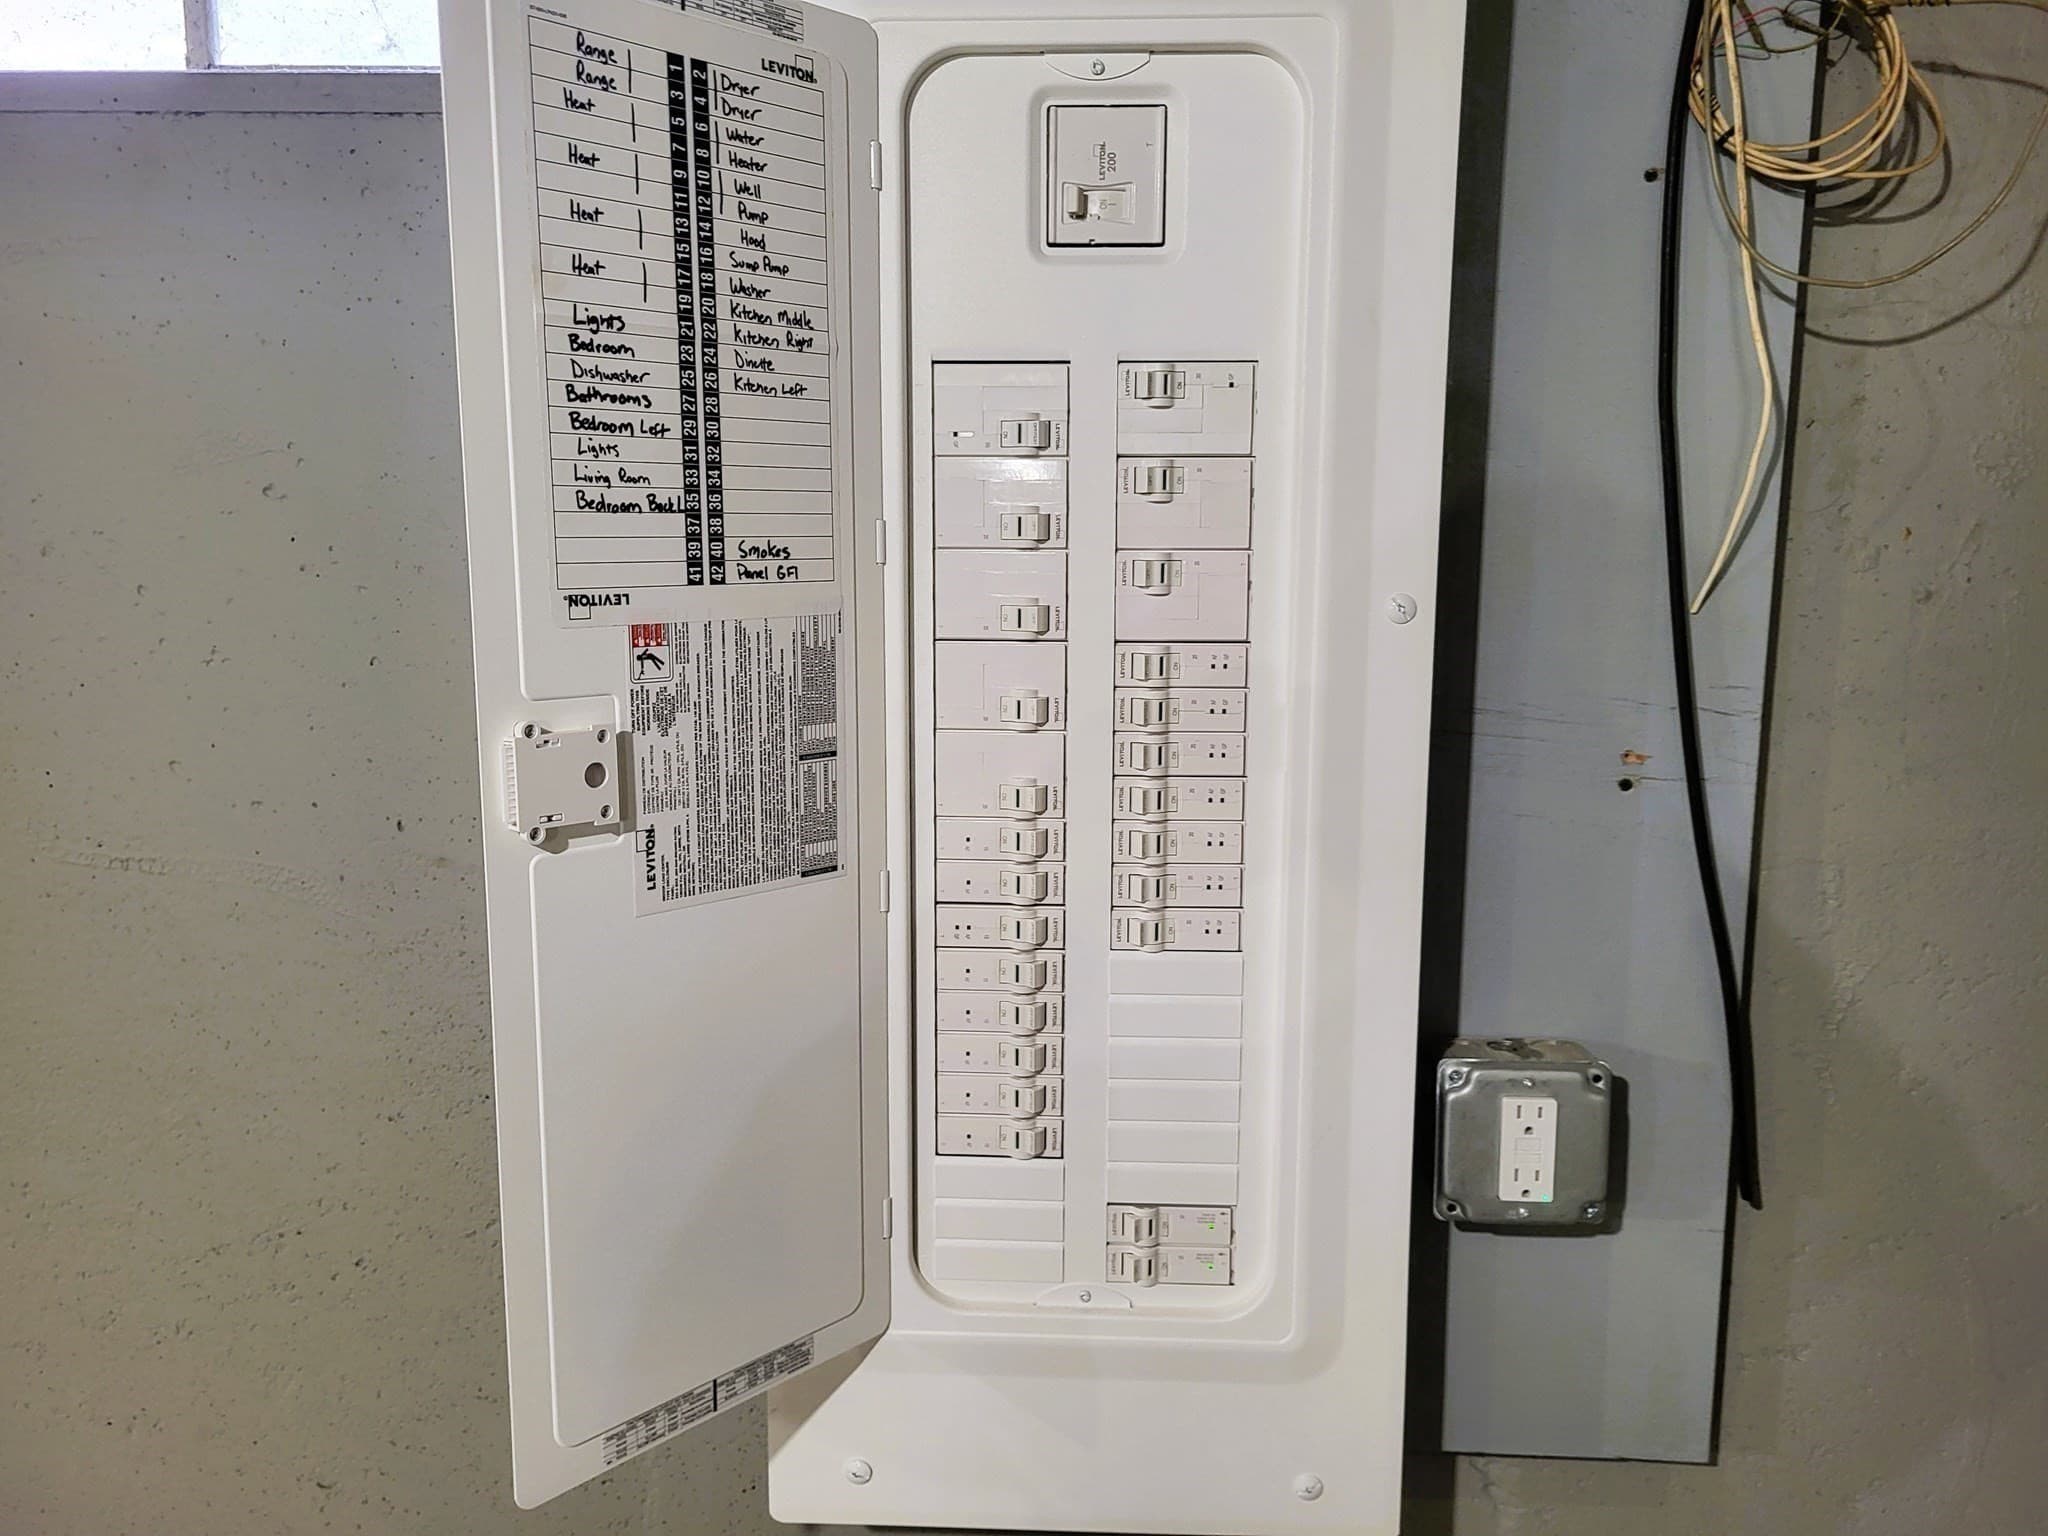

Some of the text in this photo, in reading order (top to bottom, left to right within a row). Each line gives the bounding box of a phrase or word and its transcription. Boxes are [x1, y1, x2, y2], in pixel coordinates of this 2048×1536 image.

[576, 31, 617, 65] Range
[576, 60, 617, 91] Range
[694, 70, 706, 79] 2
[761, 58, 814, 83] LEVITON
[721, 72, 760, 97] Dryer
[563, 88, 595, 113] Heat
[671, 90, 684, 101] 3
[695, 96, 706, 105] 4
[723, 98, 762, 120] Dryer
[672, 117, 684, 126] 5
[696, 123, 707, 131] 6
[569, 143, 600, 168] Heat
[674, 144, 686, 152] 7
[697, 149, 709, 158] 8
[729, 151, 768, 174] Heater
[1107, 152, 1116, 172] 200
[674, 170, 687, 178] 9
[698, 171, 710, 188] 10
[734, 179, 761, 199] Well
[675, 193, 688, 207] 11
[699, 196, 711, 213] 12
[570, 199, 604, 223] Heat
[738, 201, 768, 223] Pump
[676, 218, 689, 233] 13
[700, 222, 712, 238] 14
[741, 231, 766, 251] Hood
[677, 243, 690, 260] 15
[701, 247, 713, 263] 16
[572, 254, 606, 276] Heat
[730, 252, 789, 277] Sump Pump
[678, 269, 691, 284] 17
[702, 272, 714, 288] 18
[730, 277, 771, 298] Washer
[679, 294, 692, 311] 19
[703, 298, 715, 314] 20
[573, 304, 625, 334] Lights
[730, 299, 814, 330] Kitchen Middle
[681, 321, 693, 337] 21
[704, 323, 715, 339] 22
[568, 333, 635, 358] Bedroom
[734, 324, 814, 352] Kitchen Right
[682, 346, 694, 361] 23
[704, 348, 716, 364] 24
[570, 359, 651, 384] Dishwasher
[682, 370, 695, 386] 25
[705, 373, 717, 389] 26
[734, 373, 808, 397] Kitchen Left
[566, 384, 652, 408] Bathrooms
[683, 395, 696, 411] 27
[706, 397, 718, 413] 28
[569, 411, 671, 437] Bedroom Left
[684, 420, 697, 437] 29
[707, 421, 719, 437] 30
[577, 437, 620, 458] Lights
[686, 445, 698, 461] 31
[707, 446, 719, 461] 32
[574, 463, 651, 488] Living Room
[686, 469, 698, 485] 33
[708, 469, 720, 485] 34
[576, 490, 642, 513] Bedroom
[687, 493, 699, 510] 35
[709, 494, 721, 510] 36
[688, 518, 700, 534] 37
[710, 518, 722, 533] 38
[689, 541, 701, 557] 39
[711, 542, 722, 557] 40
[738, 540, 791, 559] Smokes
[690, 566, 701, 581] 41
[712, 565, 724, 580] 42
[737, 565, 798, 580] Panel GFI
[568, 594, 629, 607] LEVITON
[645, 829, 656, 890] LEVITON
